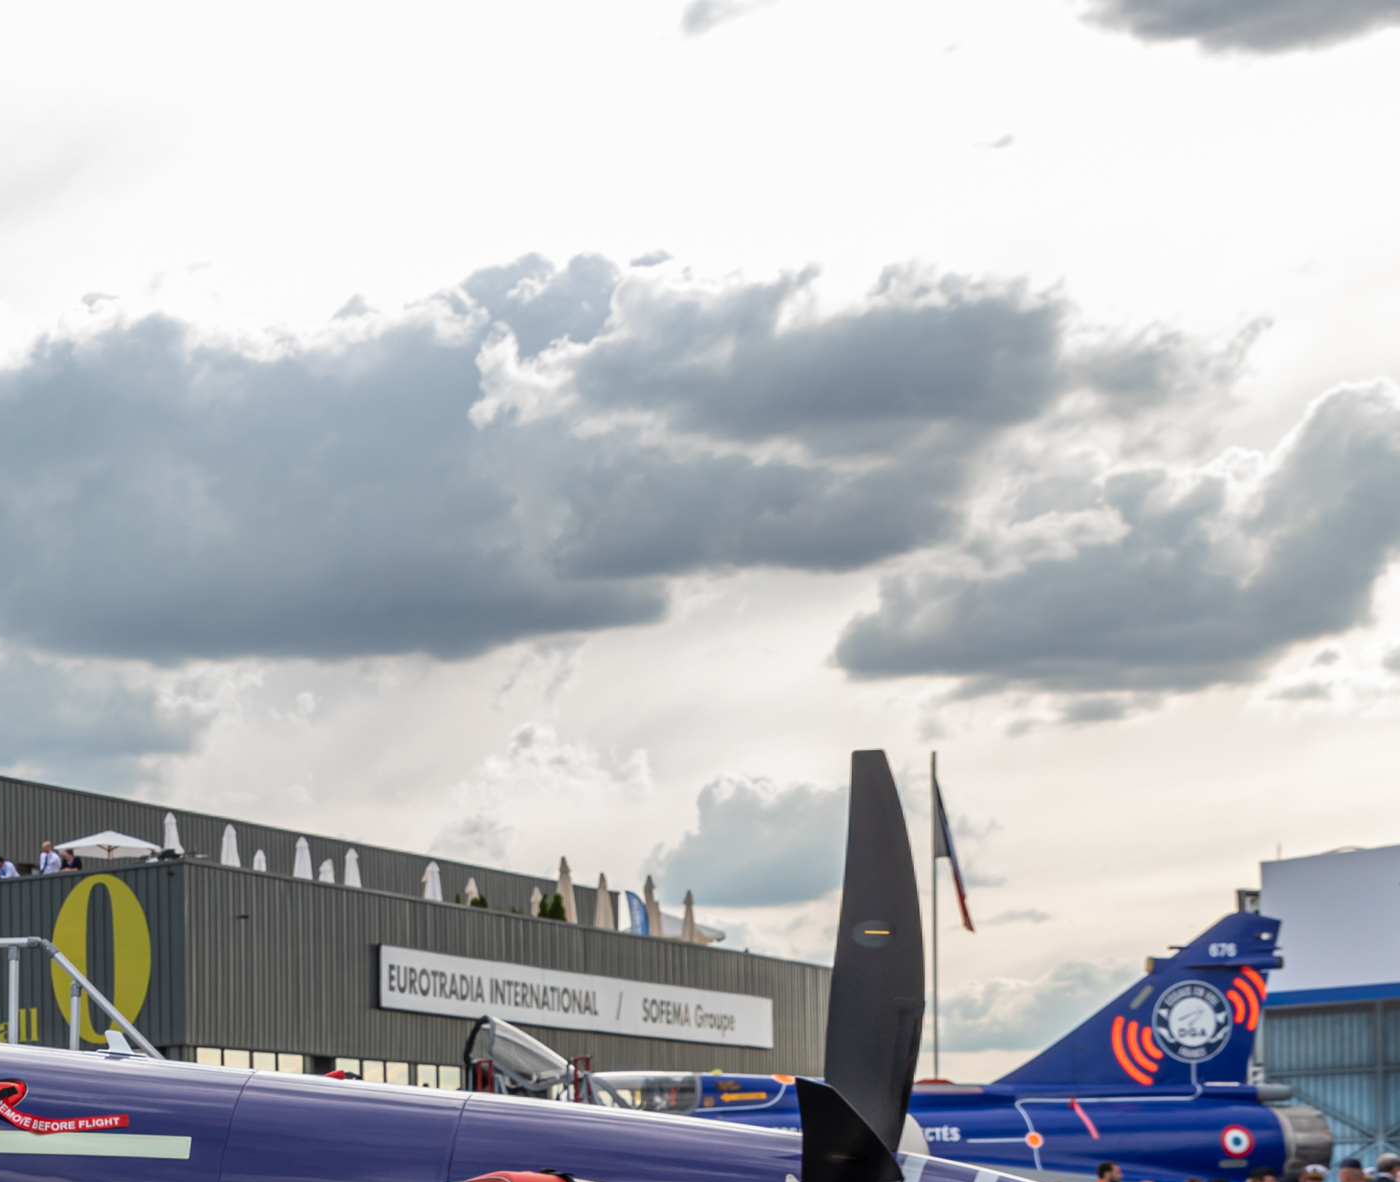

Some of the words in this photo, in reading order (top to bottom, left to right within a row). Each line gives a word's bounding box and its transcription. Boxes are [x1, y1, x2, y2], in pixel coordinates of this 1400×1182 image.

[1208, 943, 1238, 958] 676
[51, 873, 151, 1045] 0
[388, 964, 486, 1004] EUROTRADIA
[489, 977, 599, 1017] INTERNATIONAL
[641, 997, 692, 1028] SOFEMA
[695, 1004, 736, 1038] Groupe
[1178, 1028, 1207, 1038] DGA
[32, 1118, 76, 1132] BEFORE
[78, 1117, 120, 1129] FLIGHT
